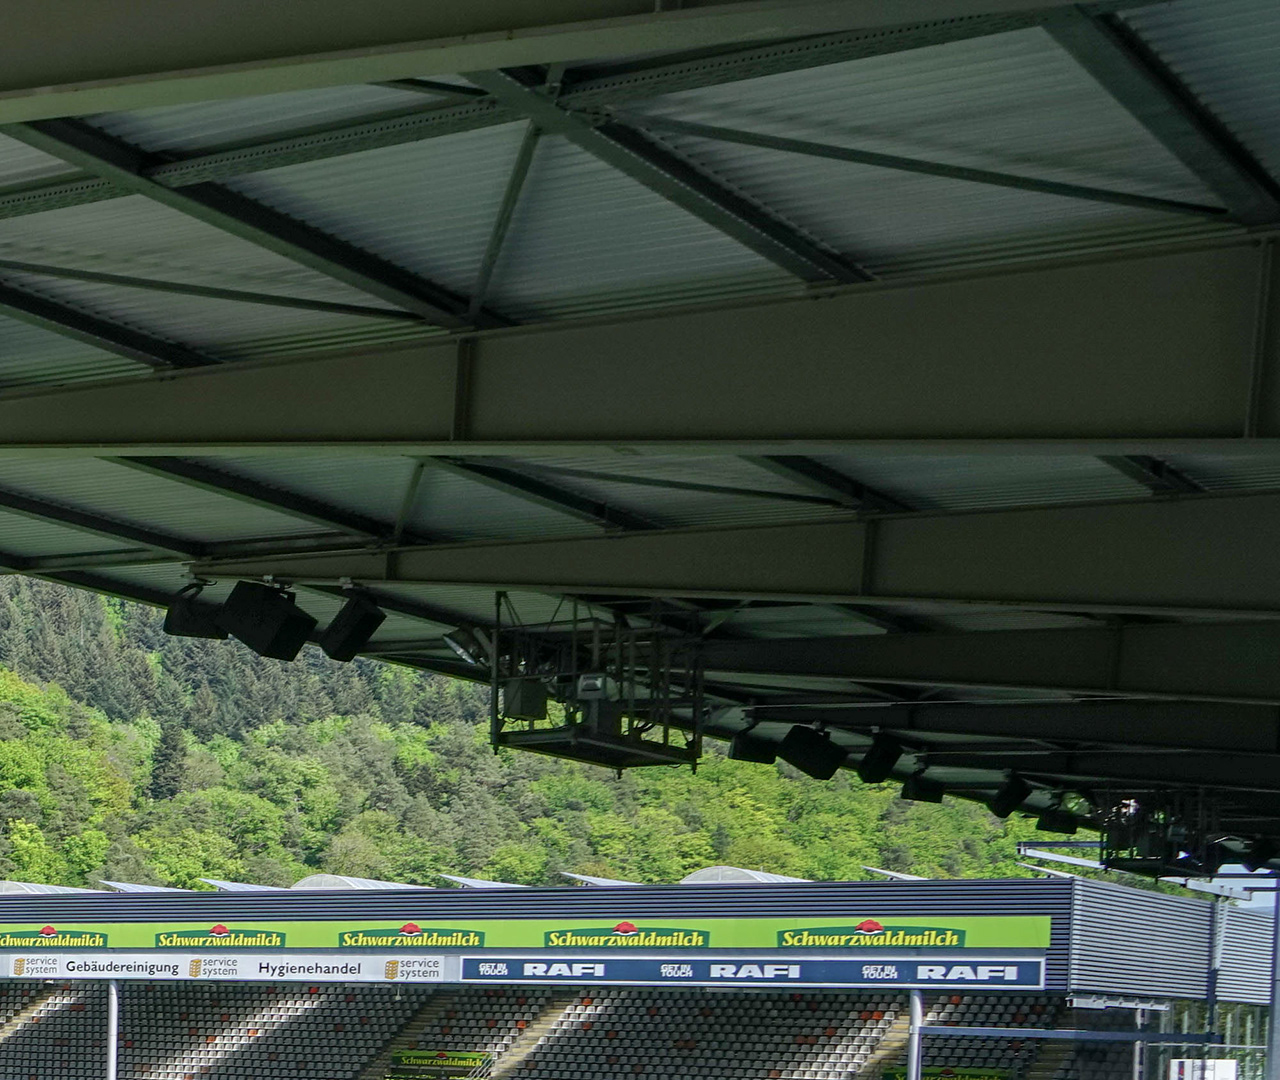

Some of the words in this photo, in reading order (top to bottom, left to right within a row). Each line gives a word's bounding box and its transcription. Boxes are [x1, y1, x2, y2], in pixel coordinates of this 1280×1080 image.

[158, 933, 281, 947] Schwarzwaldmilch
[342, 932, 480, 947] Schwarzwaldmilch
[548, 932, 704, 947] Schwarzwaldmilch
[782, 931, 959, 946] Schwarzwaldmilch
[26, 957, 58, 966] service
[66, 960, 180, 975] Gebäudereinigung
[201, 957, 238, 967] service
[398, 958, 440, 968] service
[25, 966, 58, 976] system
[201, 967, 238, 977] system
[258, 962, 362, 977] Hygienehandel
[398, 968, 440, 979] system
[523, 963, 606, 977] RAFI
[661, 970, 693, 978] TOUCH
[710, 964, 801, 979] RAFI
[863, 971, 898, 979] TOUCH
[917, 965, 1018, 980] RAFI
[400, 1057, 483, 1067] Schwarzwaldmilch
